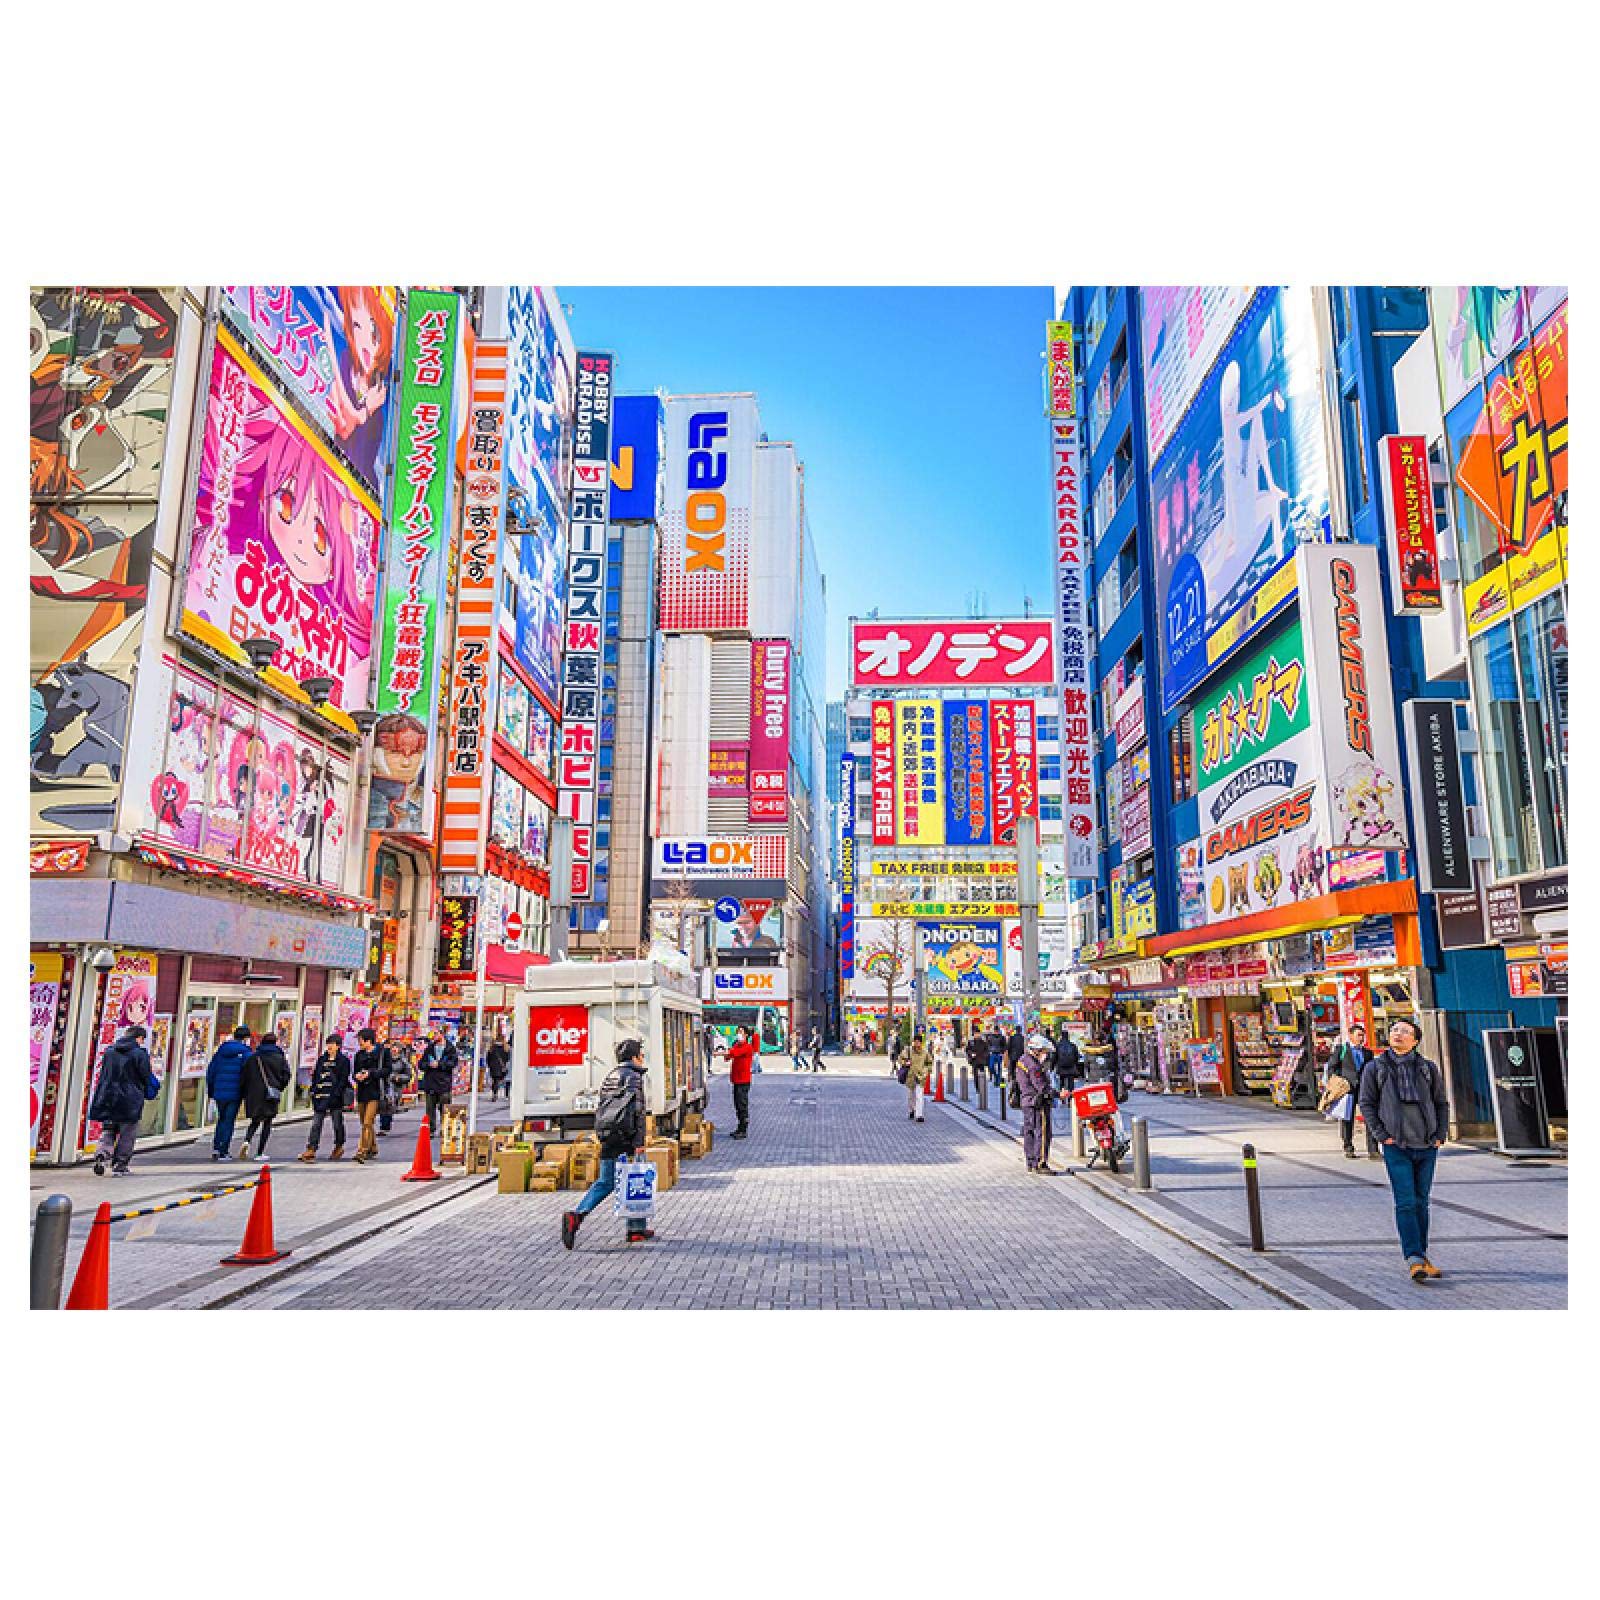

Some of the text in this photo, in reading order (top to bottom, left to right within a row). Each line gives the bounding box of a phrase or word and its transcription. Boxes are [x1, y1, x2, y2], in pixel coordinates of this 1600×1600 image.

[414, 311, 449, 386] パチスロ
[576, 358, 593, 456] PARADISE
[595, 358, 609, 423] HOBBY
[472, 408, 502, 471] 買取り
[468, 505, 492, 583] まっくす
[1056, 451, 1080, 562] TAKARADA
[856, 623, 1049, 678] オノデン
[1330, 558, 1374, 760] GAMERS
[455, 643, 482, 773] アキバ駅前店
[764, 645, 787, 739] Duty Free
[874, 706, 892, 837] 免税 TAX FREE
[1429, 713, 1456, 877] ALIENWARE STORE AKIBA
[1205, 789, 1316, 864] GAMERS
[841, 837, 853, 893] ONODEN
[879, 863, 909, 875] TAX
[911, 863, 949, 875] FREE
[878, 903, 910, 916] テレビ
[949, 903, 991, 915] エアコン
